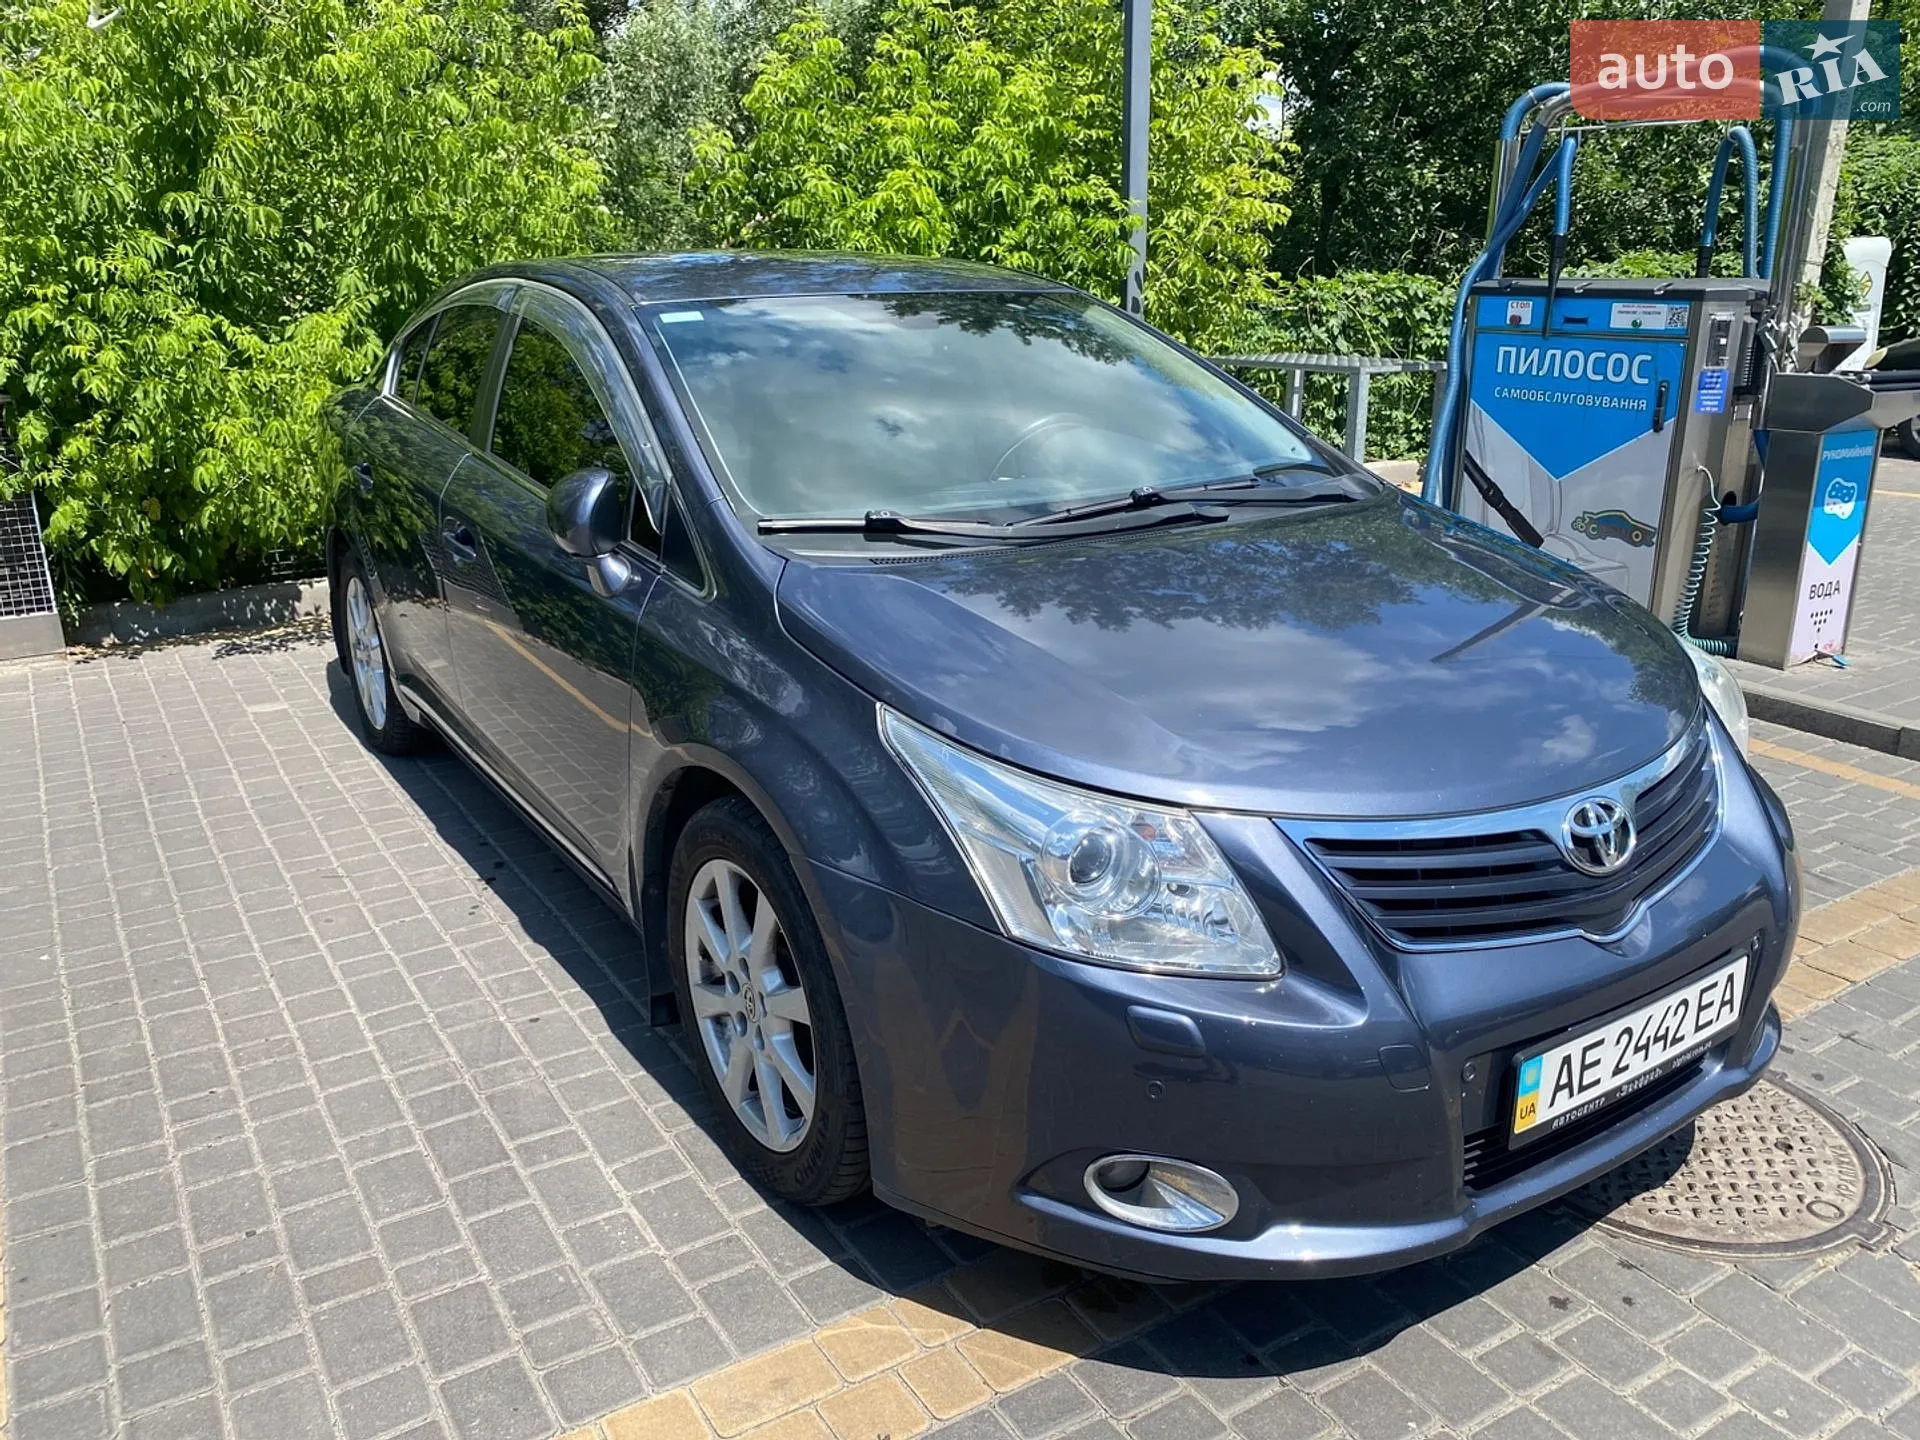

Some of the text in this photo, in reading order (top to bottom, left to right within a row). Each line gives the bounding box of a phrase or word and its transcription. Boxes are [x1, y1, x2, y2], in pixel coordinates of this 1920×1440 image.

[1497, 345, 1652, 384] ПИЛОСОС
[1494, 386, 1647, 411] САМООБСЛУГОВУВАННЯ
[1809, 579, 1841, 601] ВОДА
[1548, 1037, 1605, 1109] AE
[1611, 997, 1689, 1078] 2442
[1693, 971, 1735, 1034] EA
[1519, 1101, 1536, 1120] UA
